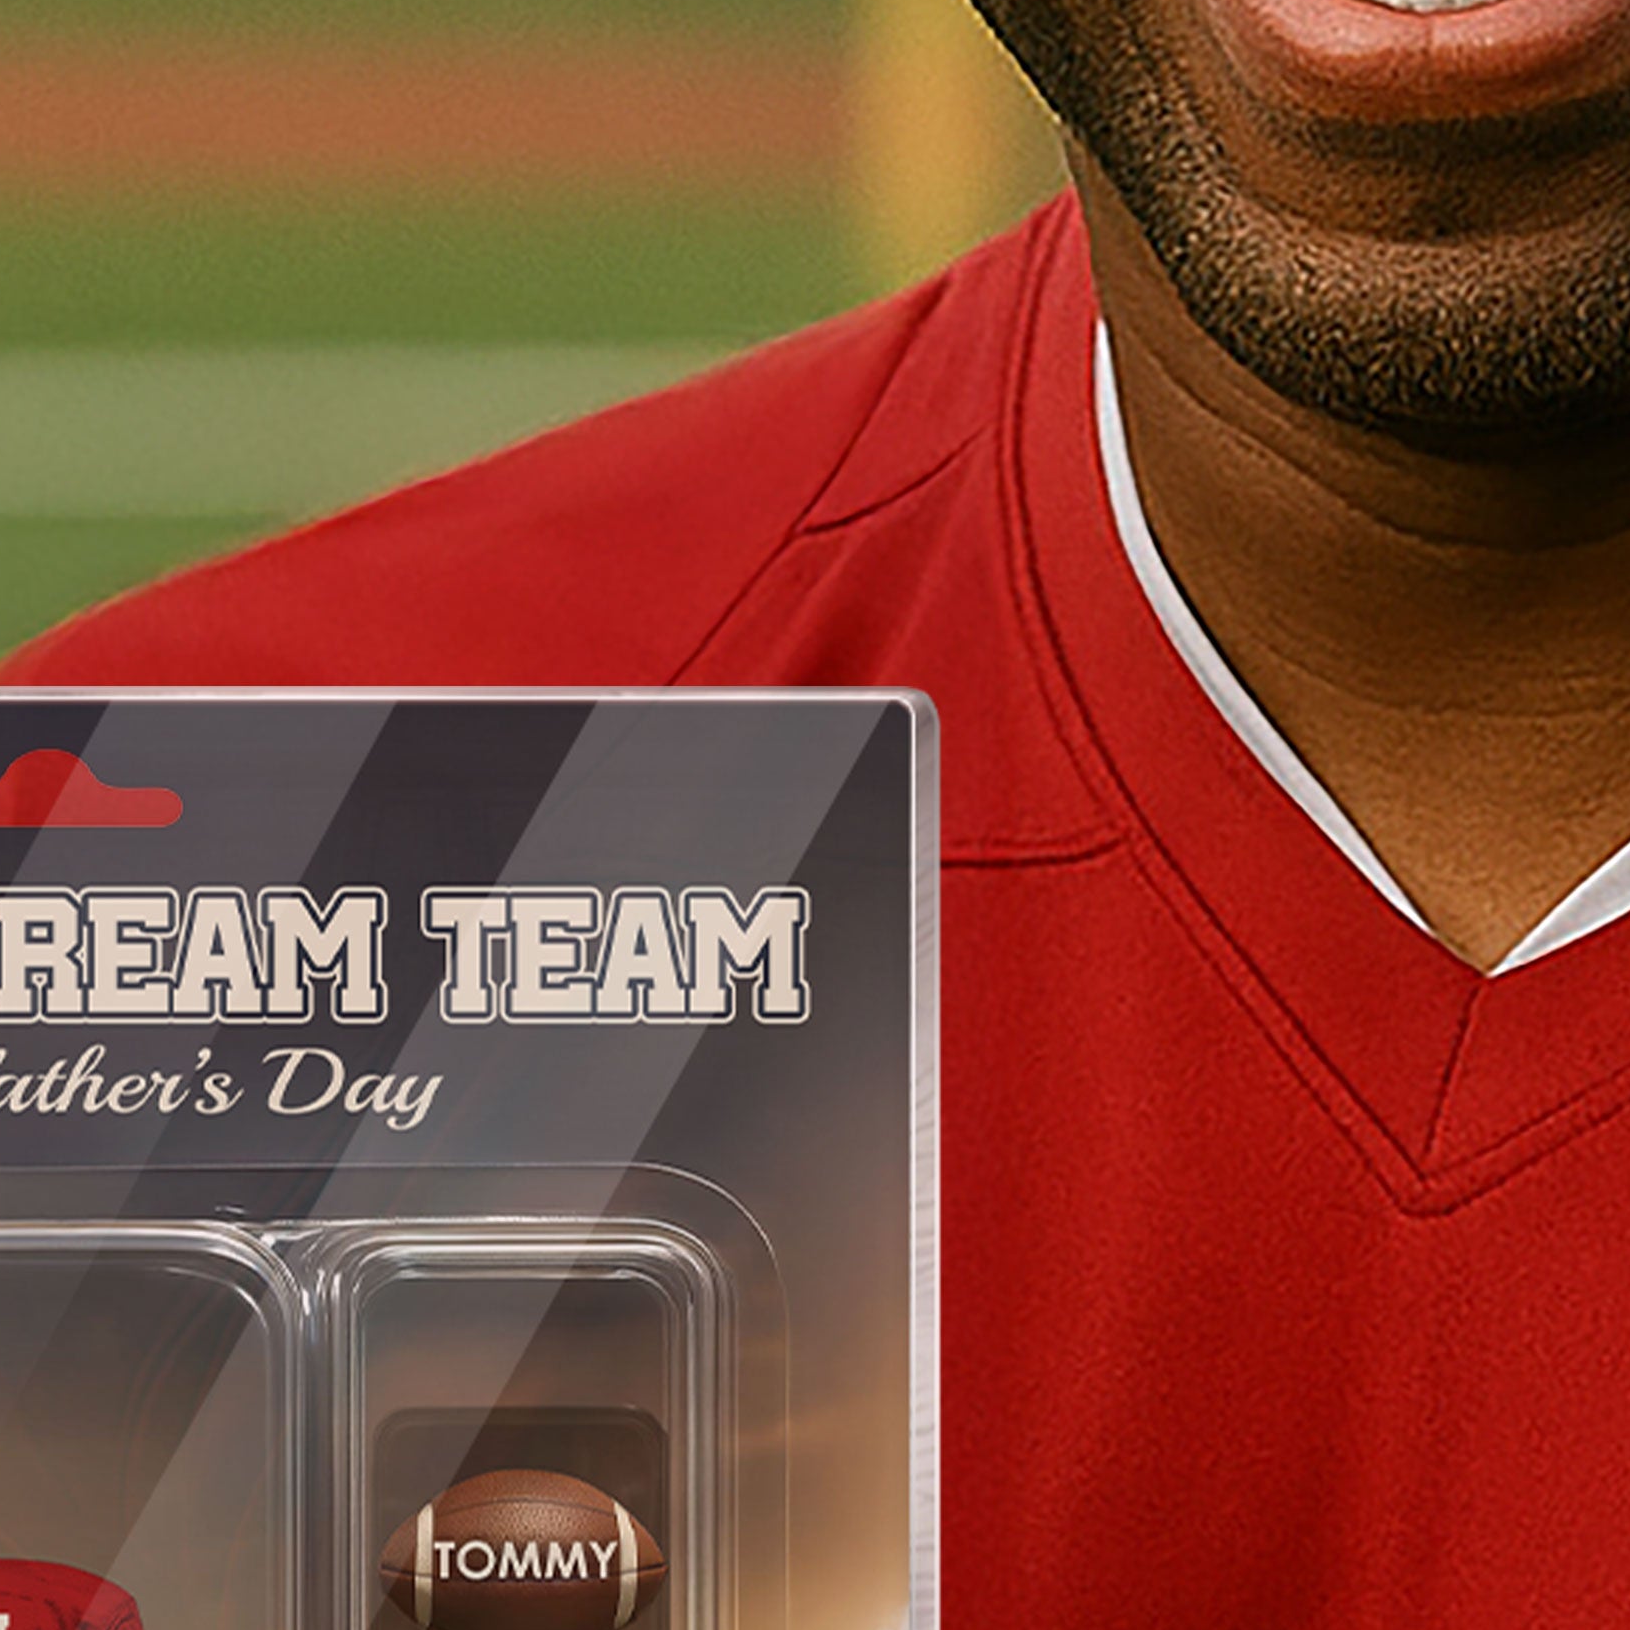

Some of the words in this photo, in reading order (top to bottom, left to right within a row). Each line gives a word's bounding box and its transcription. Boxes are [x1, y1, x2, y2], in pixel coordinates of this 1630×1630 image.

[419, 885, 811, 1025] TEAM
[261, 1046, 444, 1132] Day
[432, 1539, 619, 1580] TOMMY
